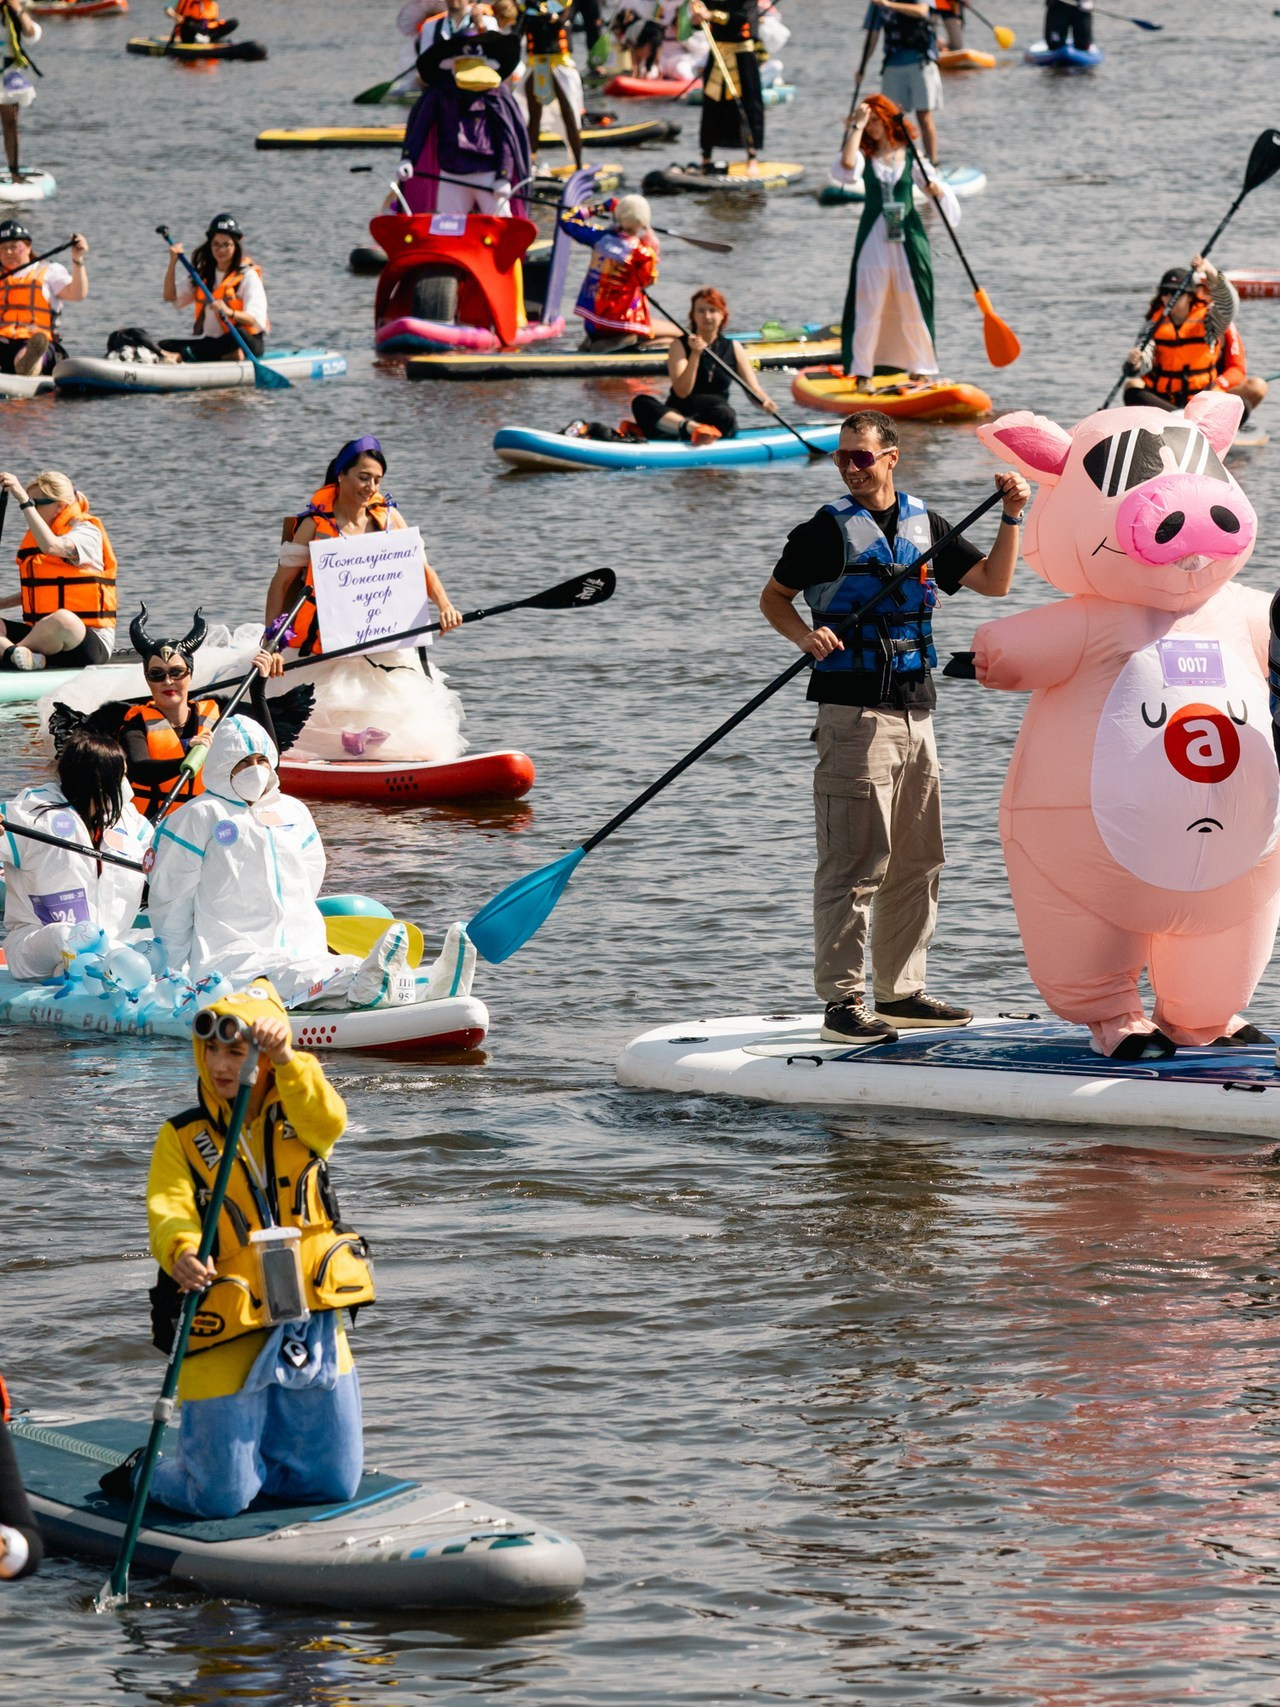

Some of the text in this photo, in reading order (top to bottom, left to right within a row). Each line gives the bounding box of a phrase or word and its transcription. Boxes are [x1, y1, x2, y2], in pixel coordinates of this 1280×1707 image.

[318, 545, 418, 570] Пожалуйста!
[338, 570, 404, 588] Донесите
[352, 585, 393, 607] мусор
[366, 607, 382, 624] до
[355, 622, 398, 644] урны!
[1178, 656, 1207, 673] 0017
[193, 1129, 222, 1170] VIVA
